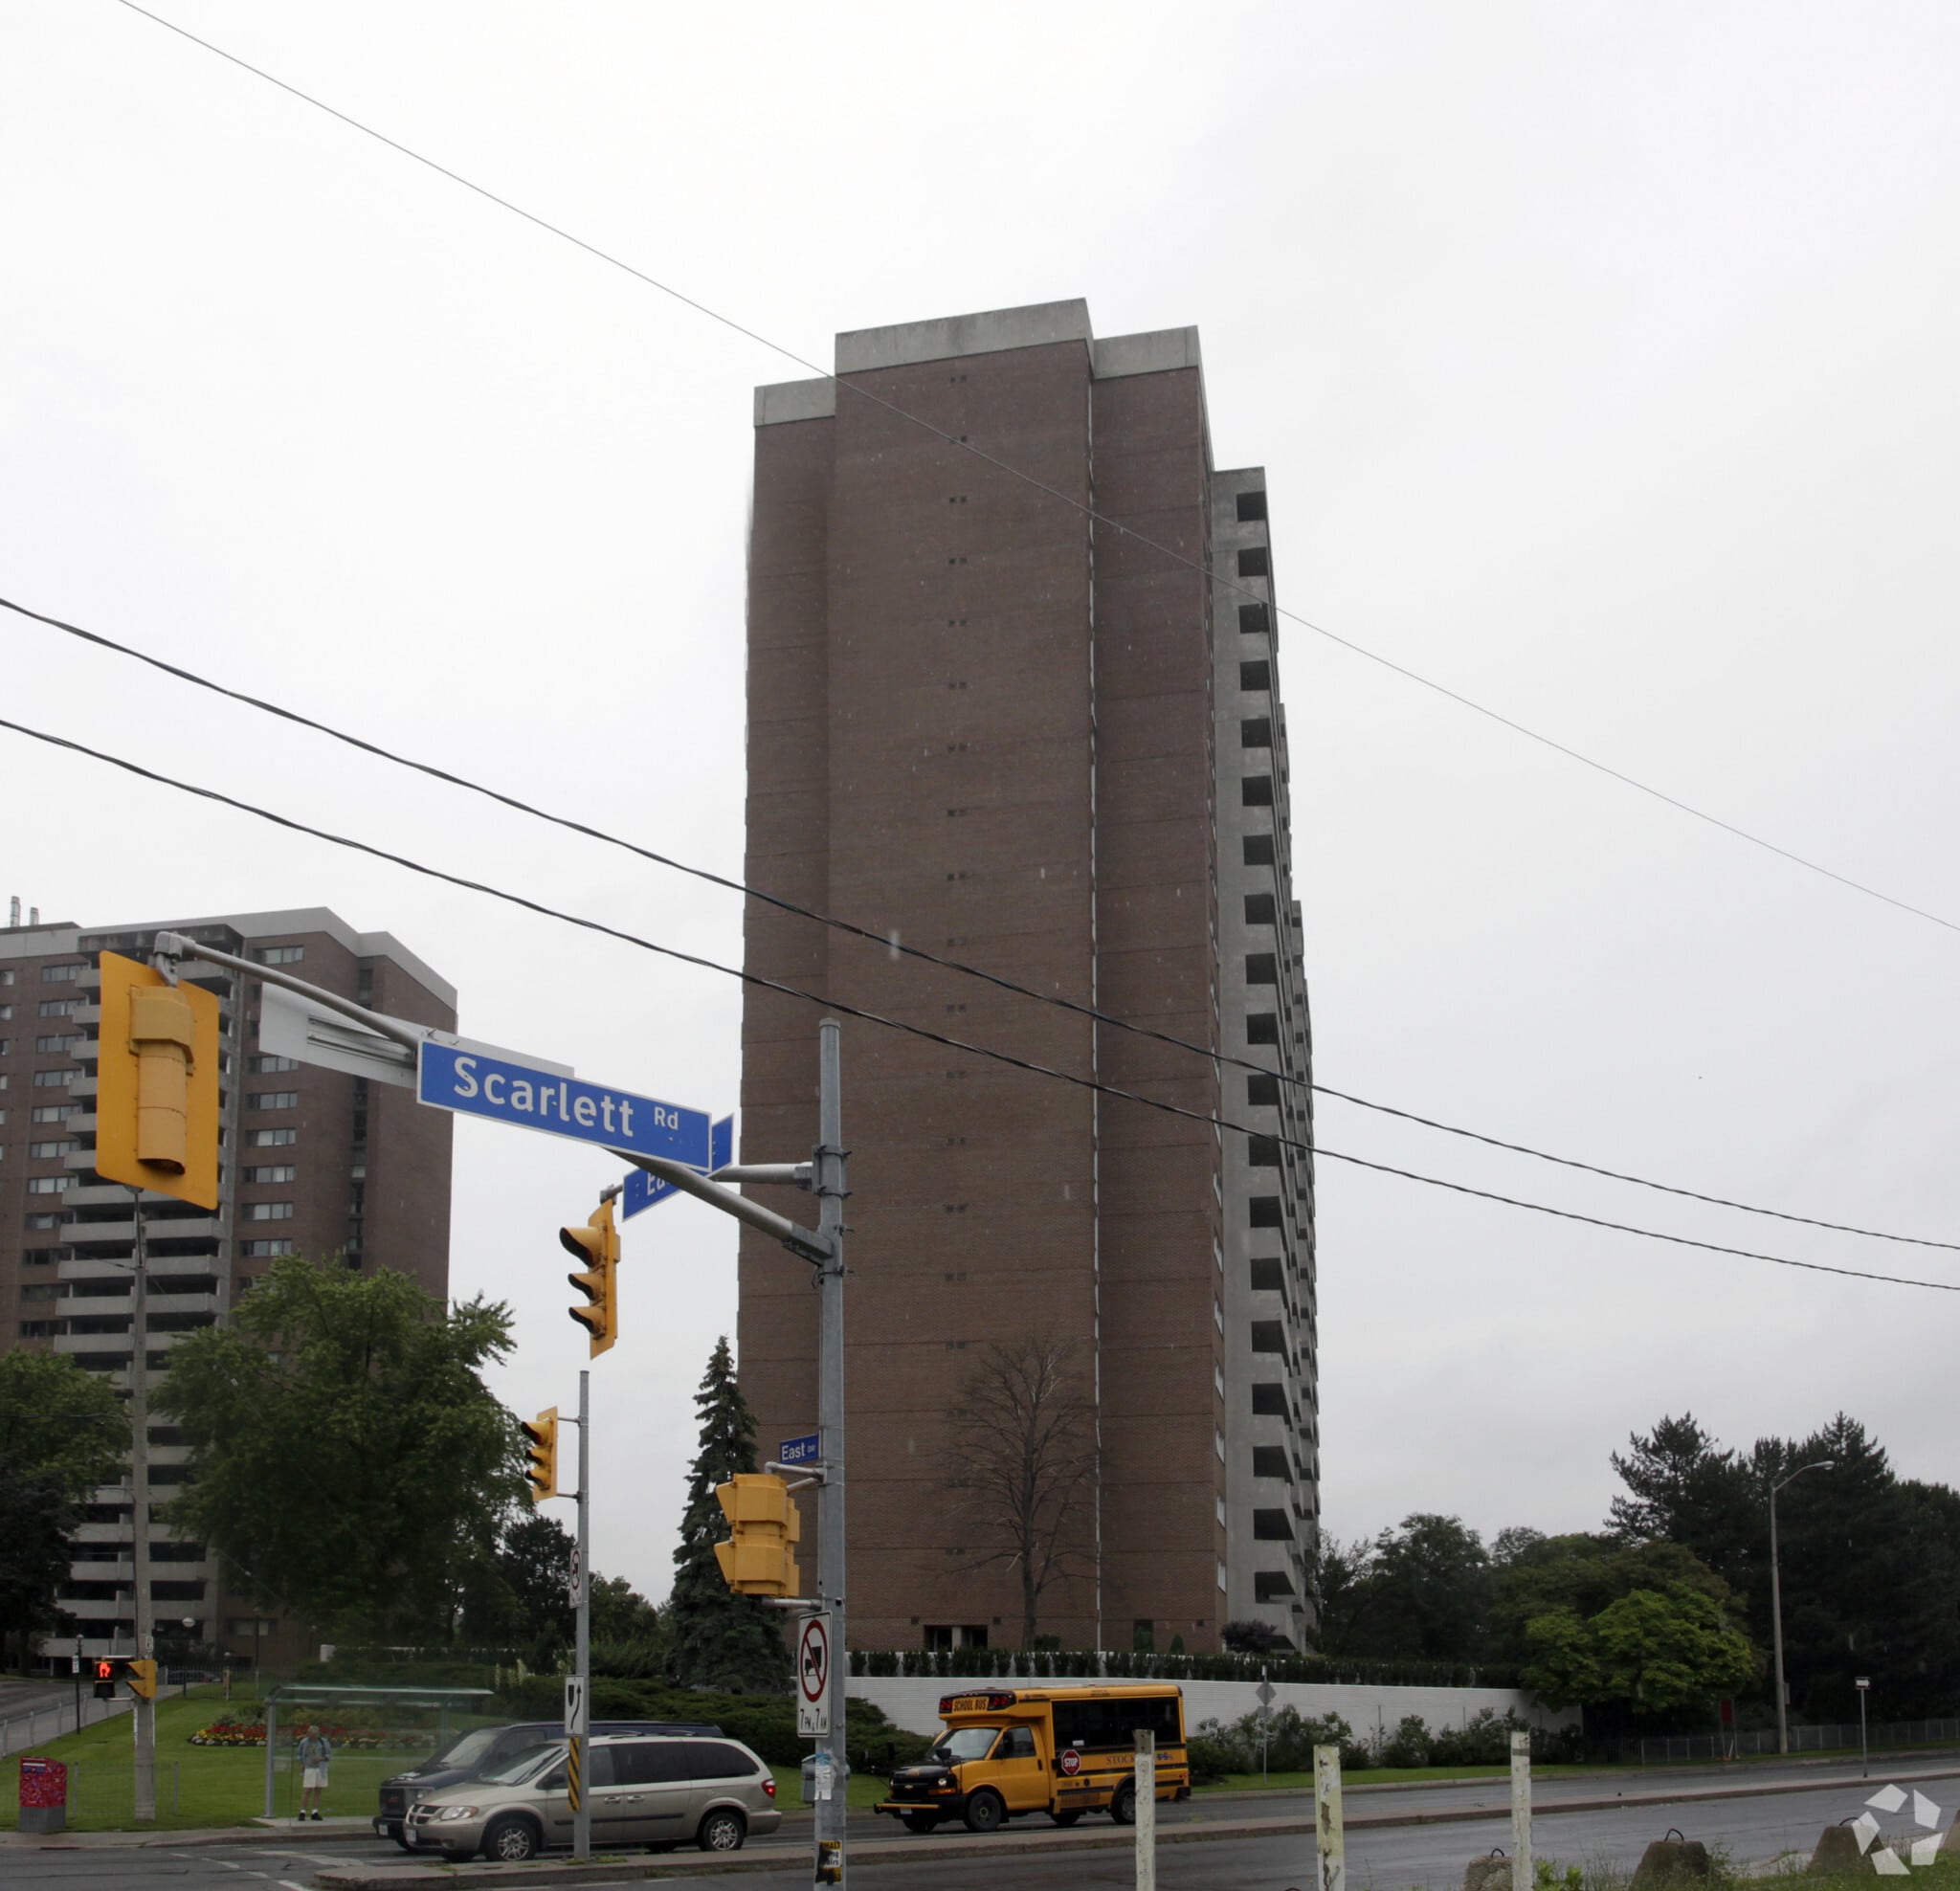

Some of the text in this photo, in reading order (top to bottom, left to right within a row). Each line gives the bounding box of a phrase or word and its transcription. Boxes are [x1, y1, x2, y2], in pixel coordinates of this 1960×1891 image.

[453, 1056, 679, 1138] Scarlett Rd
[781, 1442, 805, 1460] East
[953, 1697, 988, 1712] SCHOOL BUS
[1063, 1757, 1079, 1768] STOP
